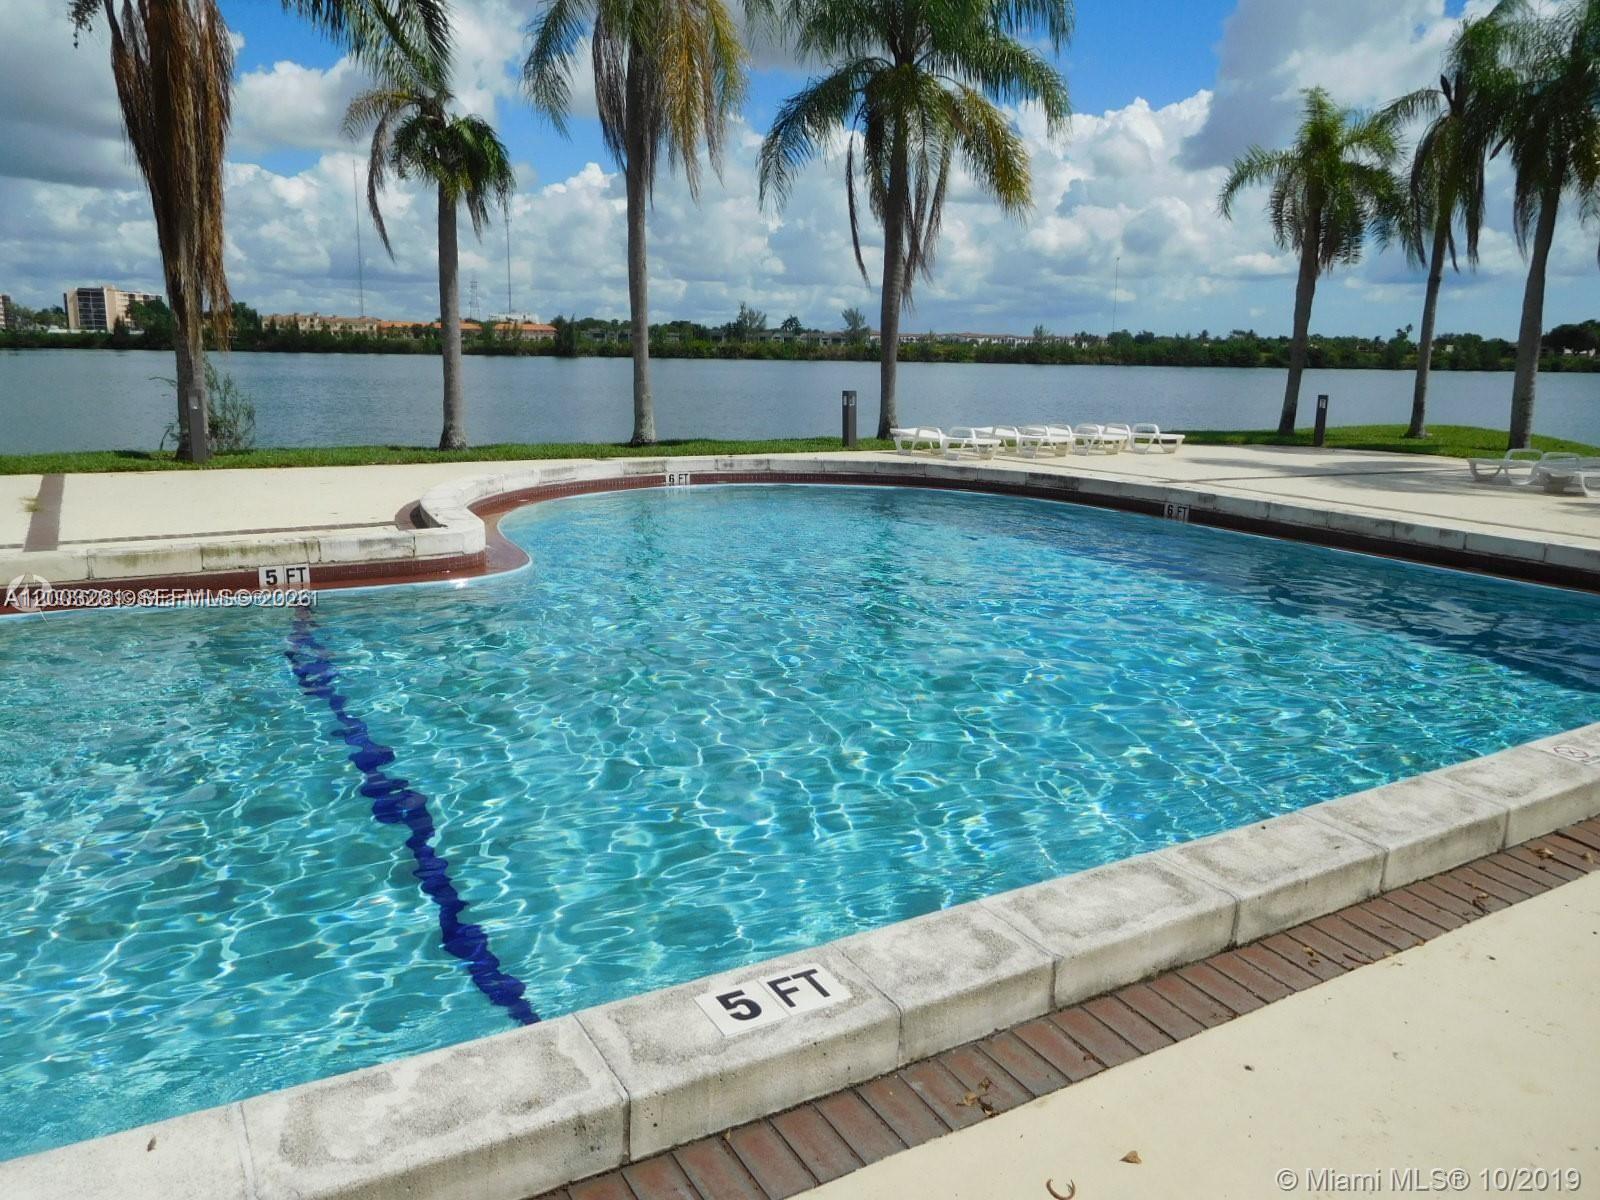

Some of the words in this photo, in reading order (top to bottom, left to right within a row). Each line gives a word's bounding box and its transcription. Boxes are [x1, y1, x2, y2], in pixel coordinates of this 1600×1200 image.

[668, 473, 675, 484] 6
[678, 473, 689, 486] FT
[265, 569, 278, 585] 5
[285, 566, 307, 588] FT
[715, 989, 763, 1022] 5
[765, 967, 832, 1009] FT
